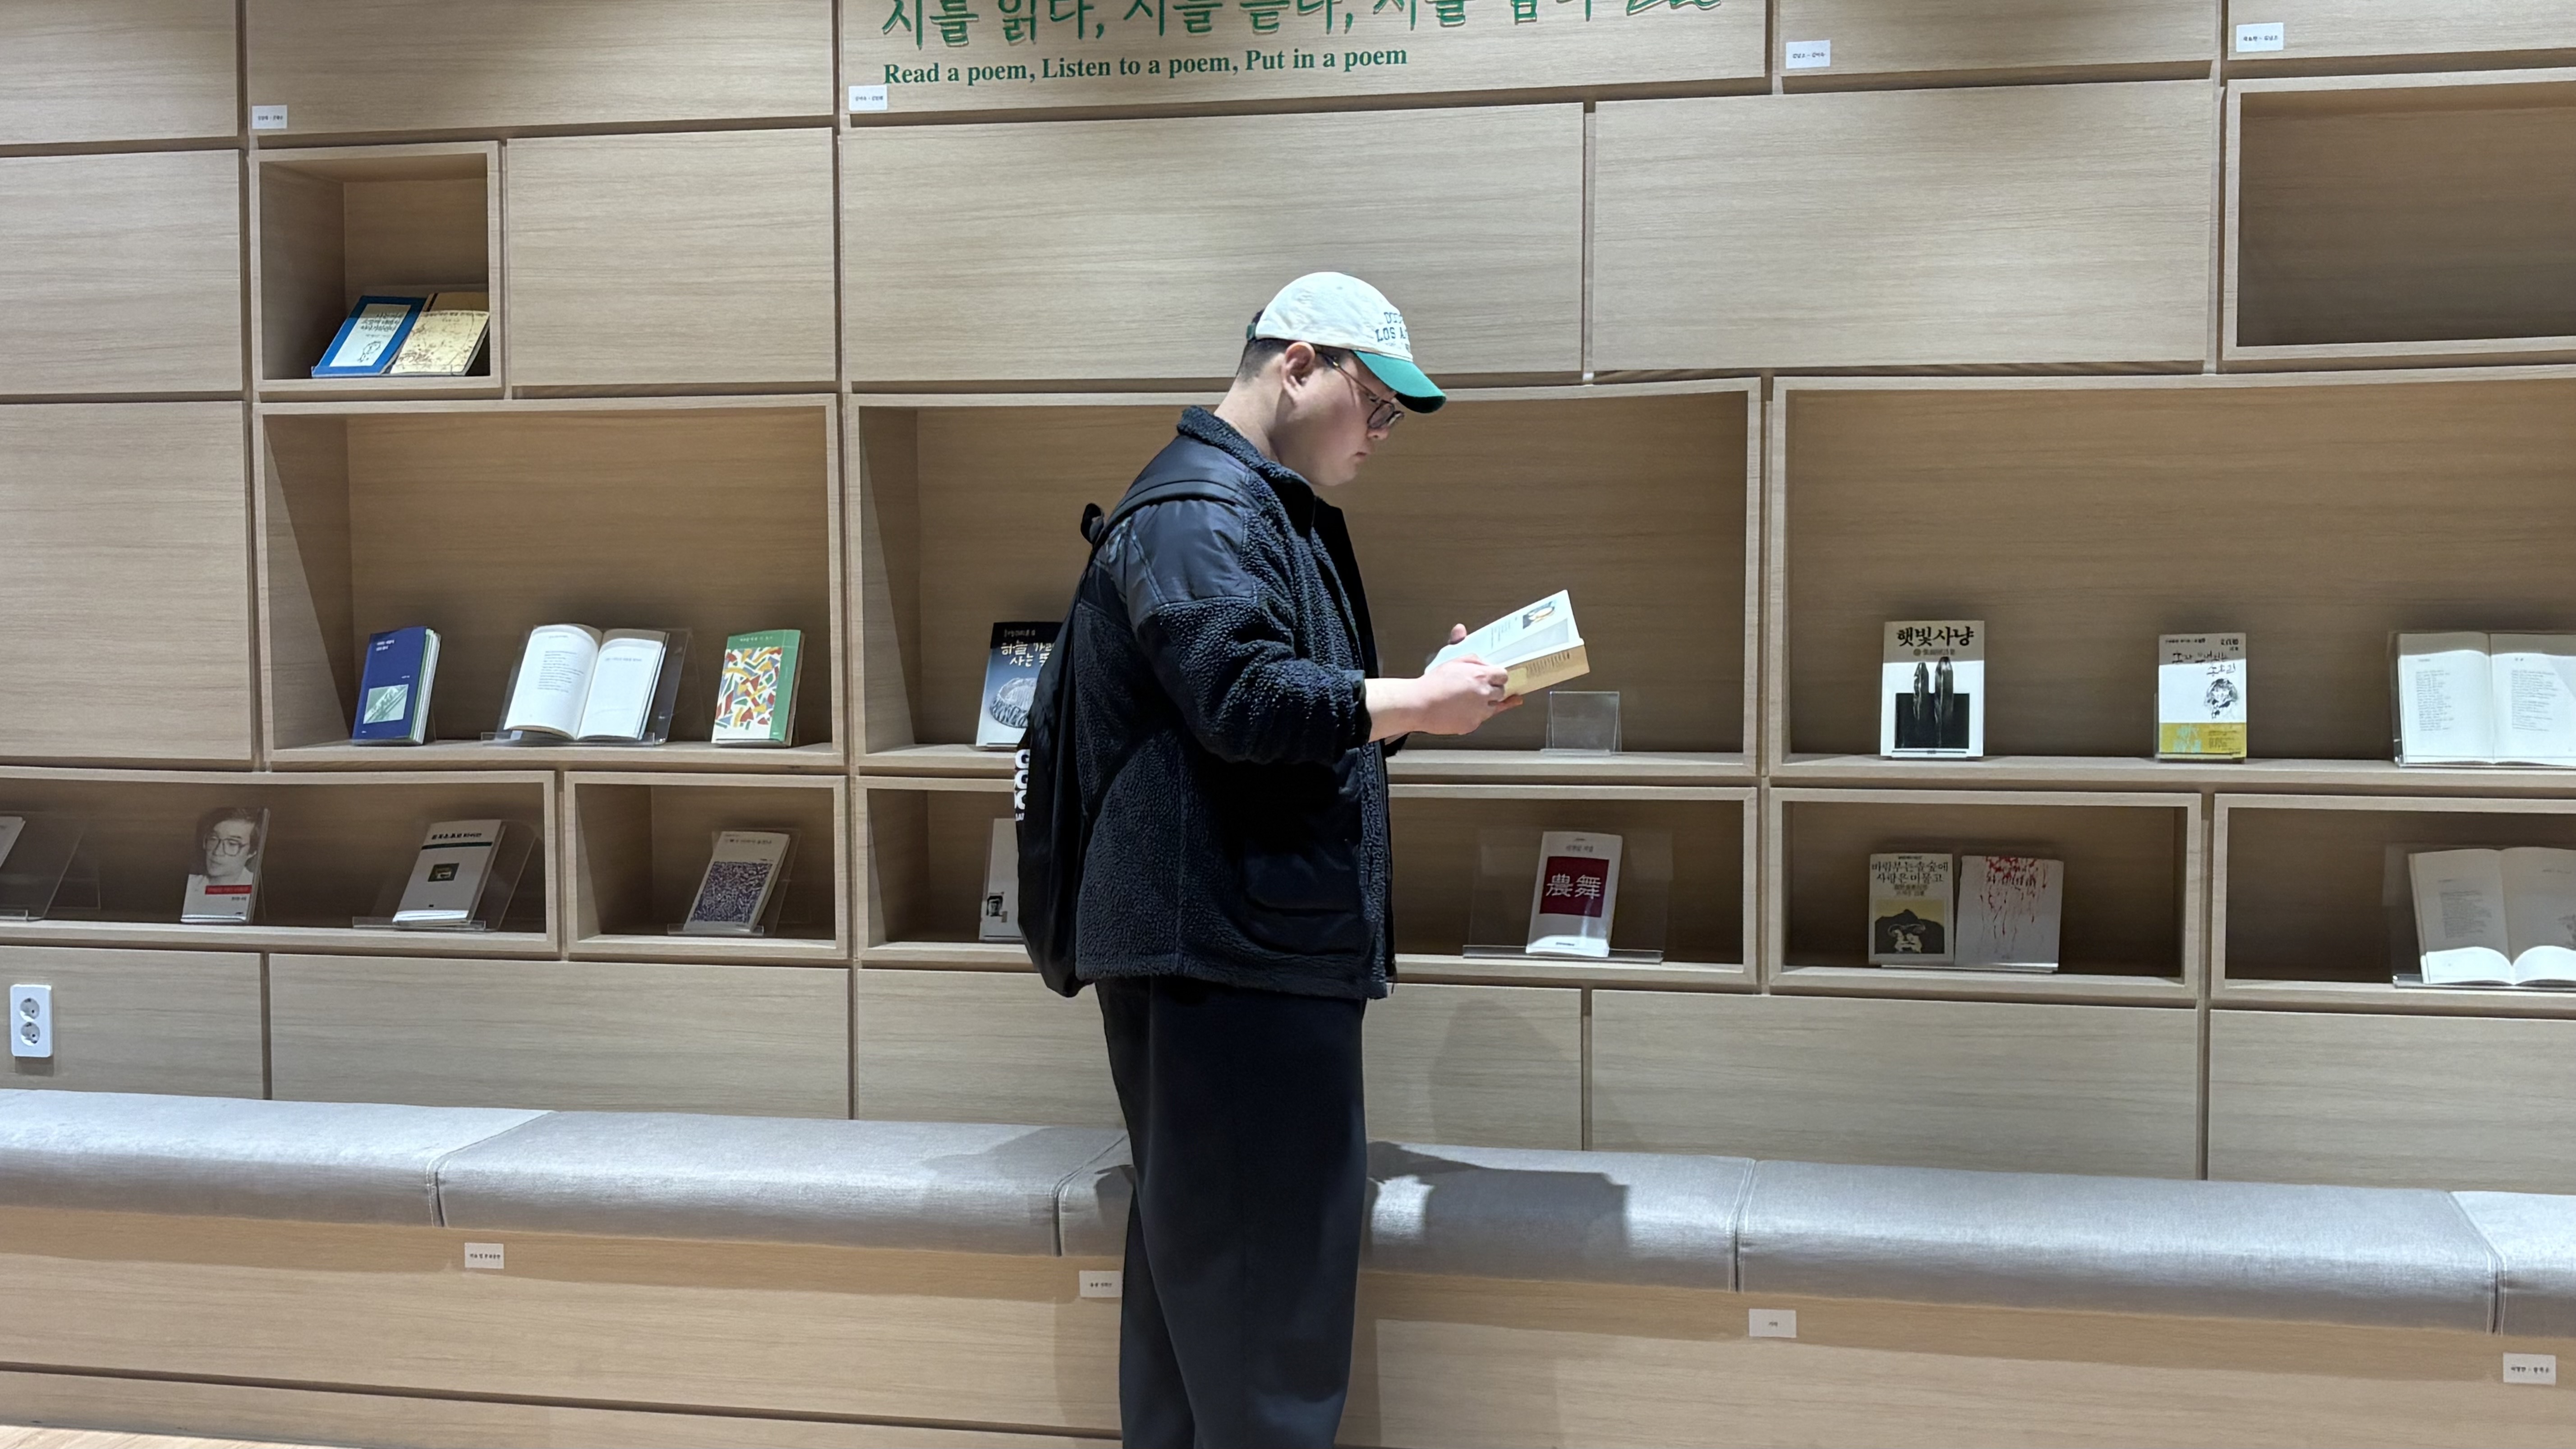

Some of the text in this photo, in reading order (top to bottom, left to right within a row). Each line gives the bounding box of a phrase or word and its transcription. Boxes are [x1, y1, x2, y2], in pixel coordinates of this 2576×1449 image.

[884, 48, 1407, 86] Read a poem, Listen to a poem, Put in a poem
[1375, 326, 1396, 343] LOS
[1546, 873, 1601, 899] 農舞
